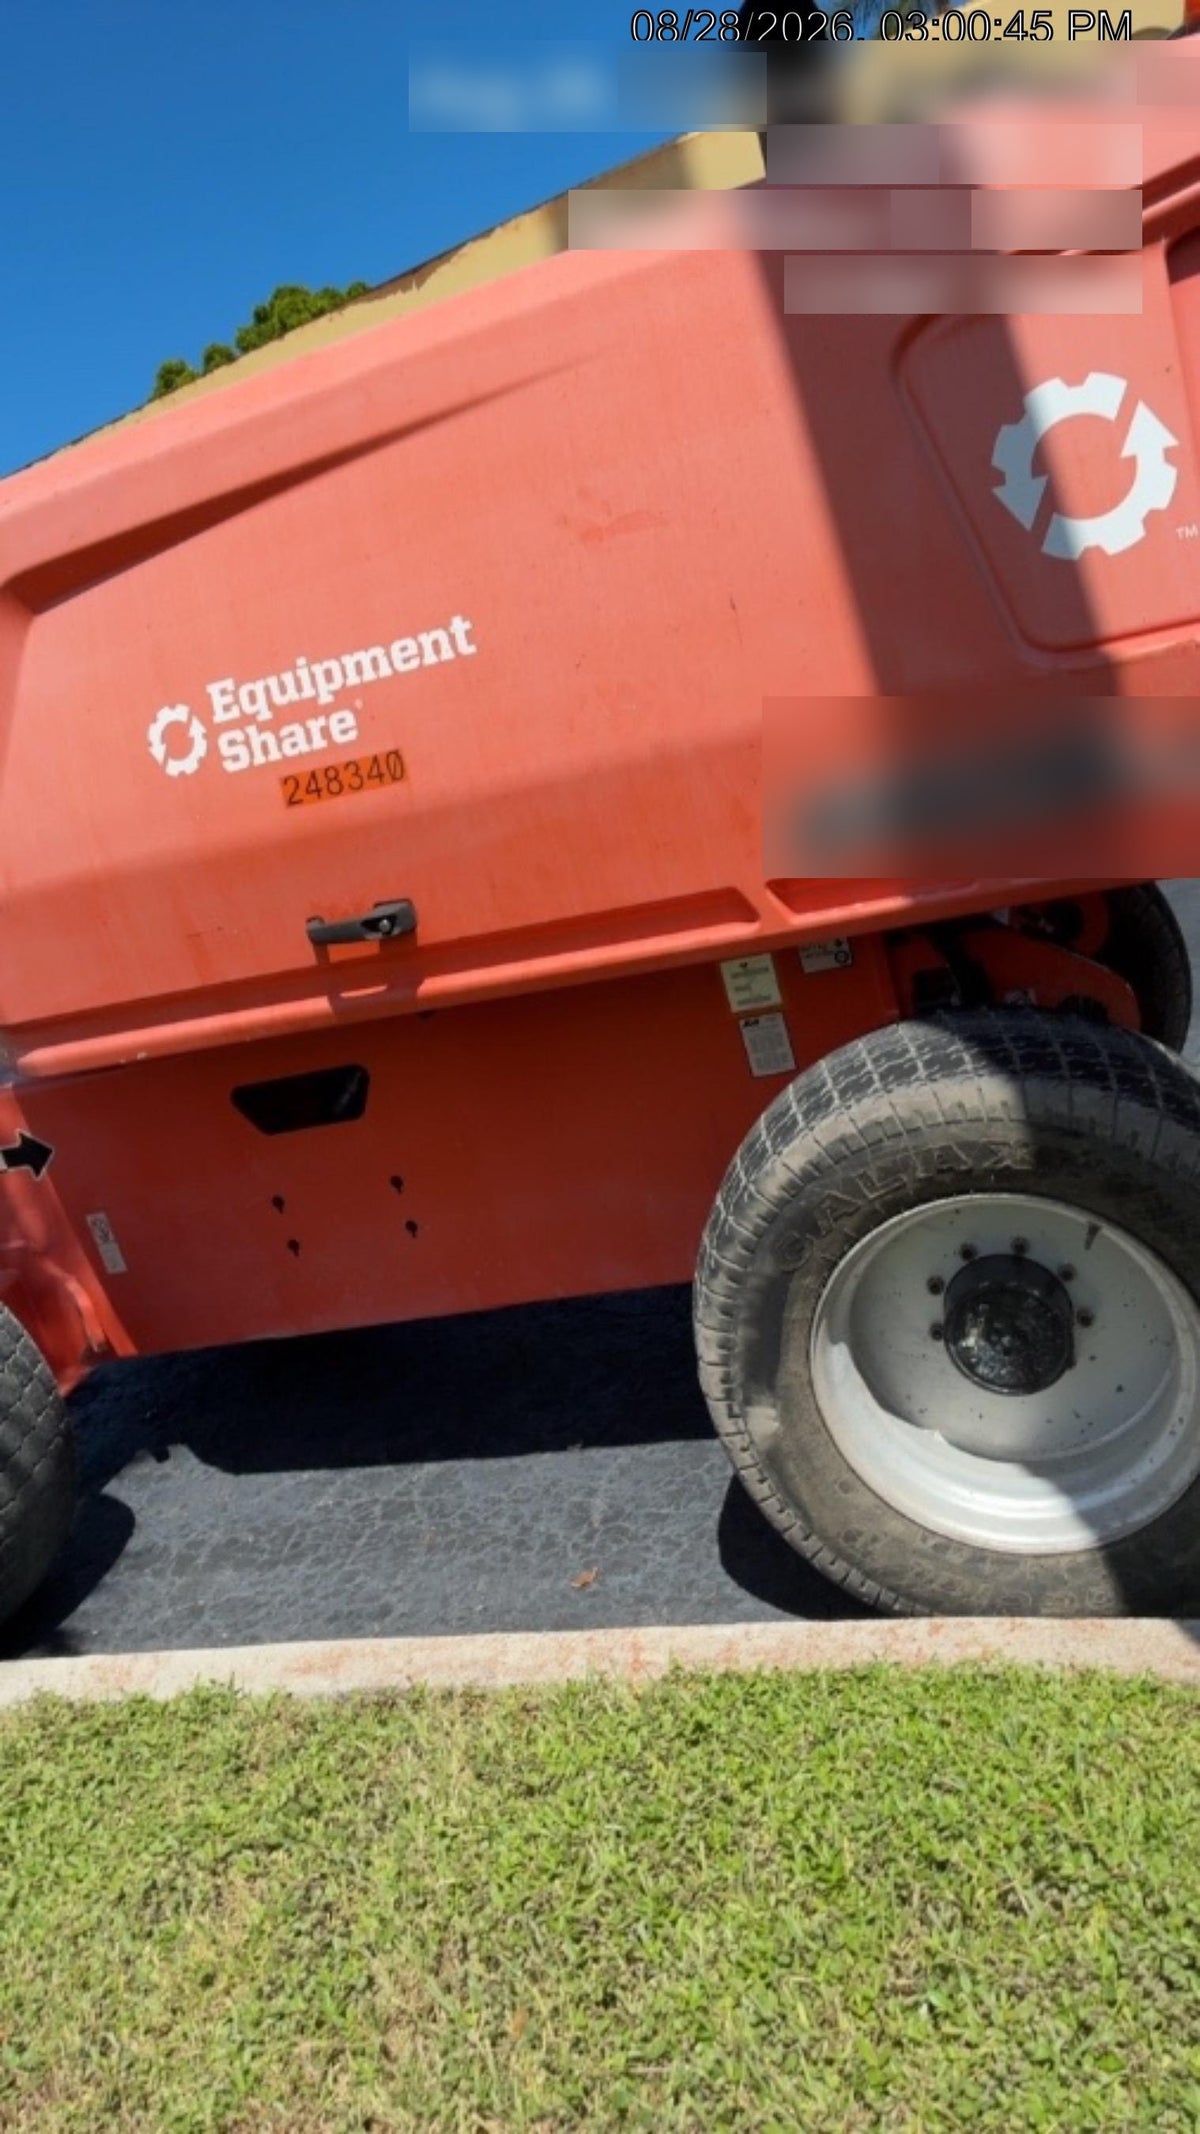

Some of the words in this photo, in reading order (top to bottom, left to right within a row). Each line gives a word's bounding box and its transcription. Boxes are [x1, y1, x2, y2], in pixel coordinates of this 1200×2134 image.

[206, 615, 477, 722] Equipment
[218, 708, 358, 773] Share
[283, 750, 406, 807] 248340
